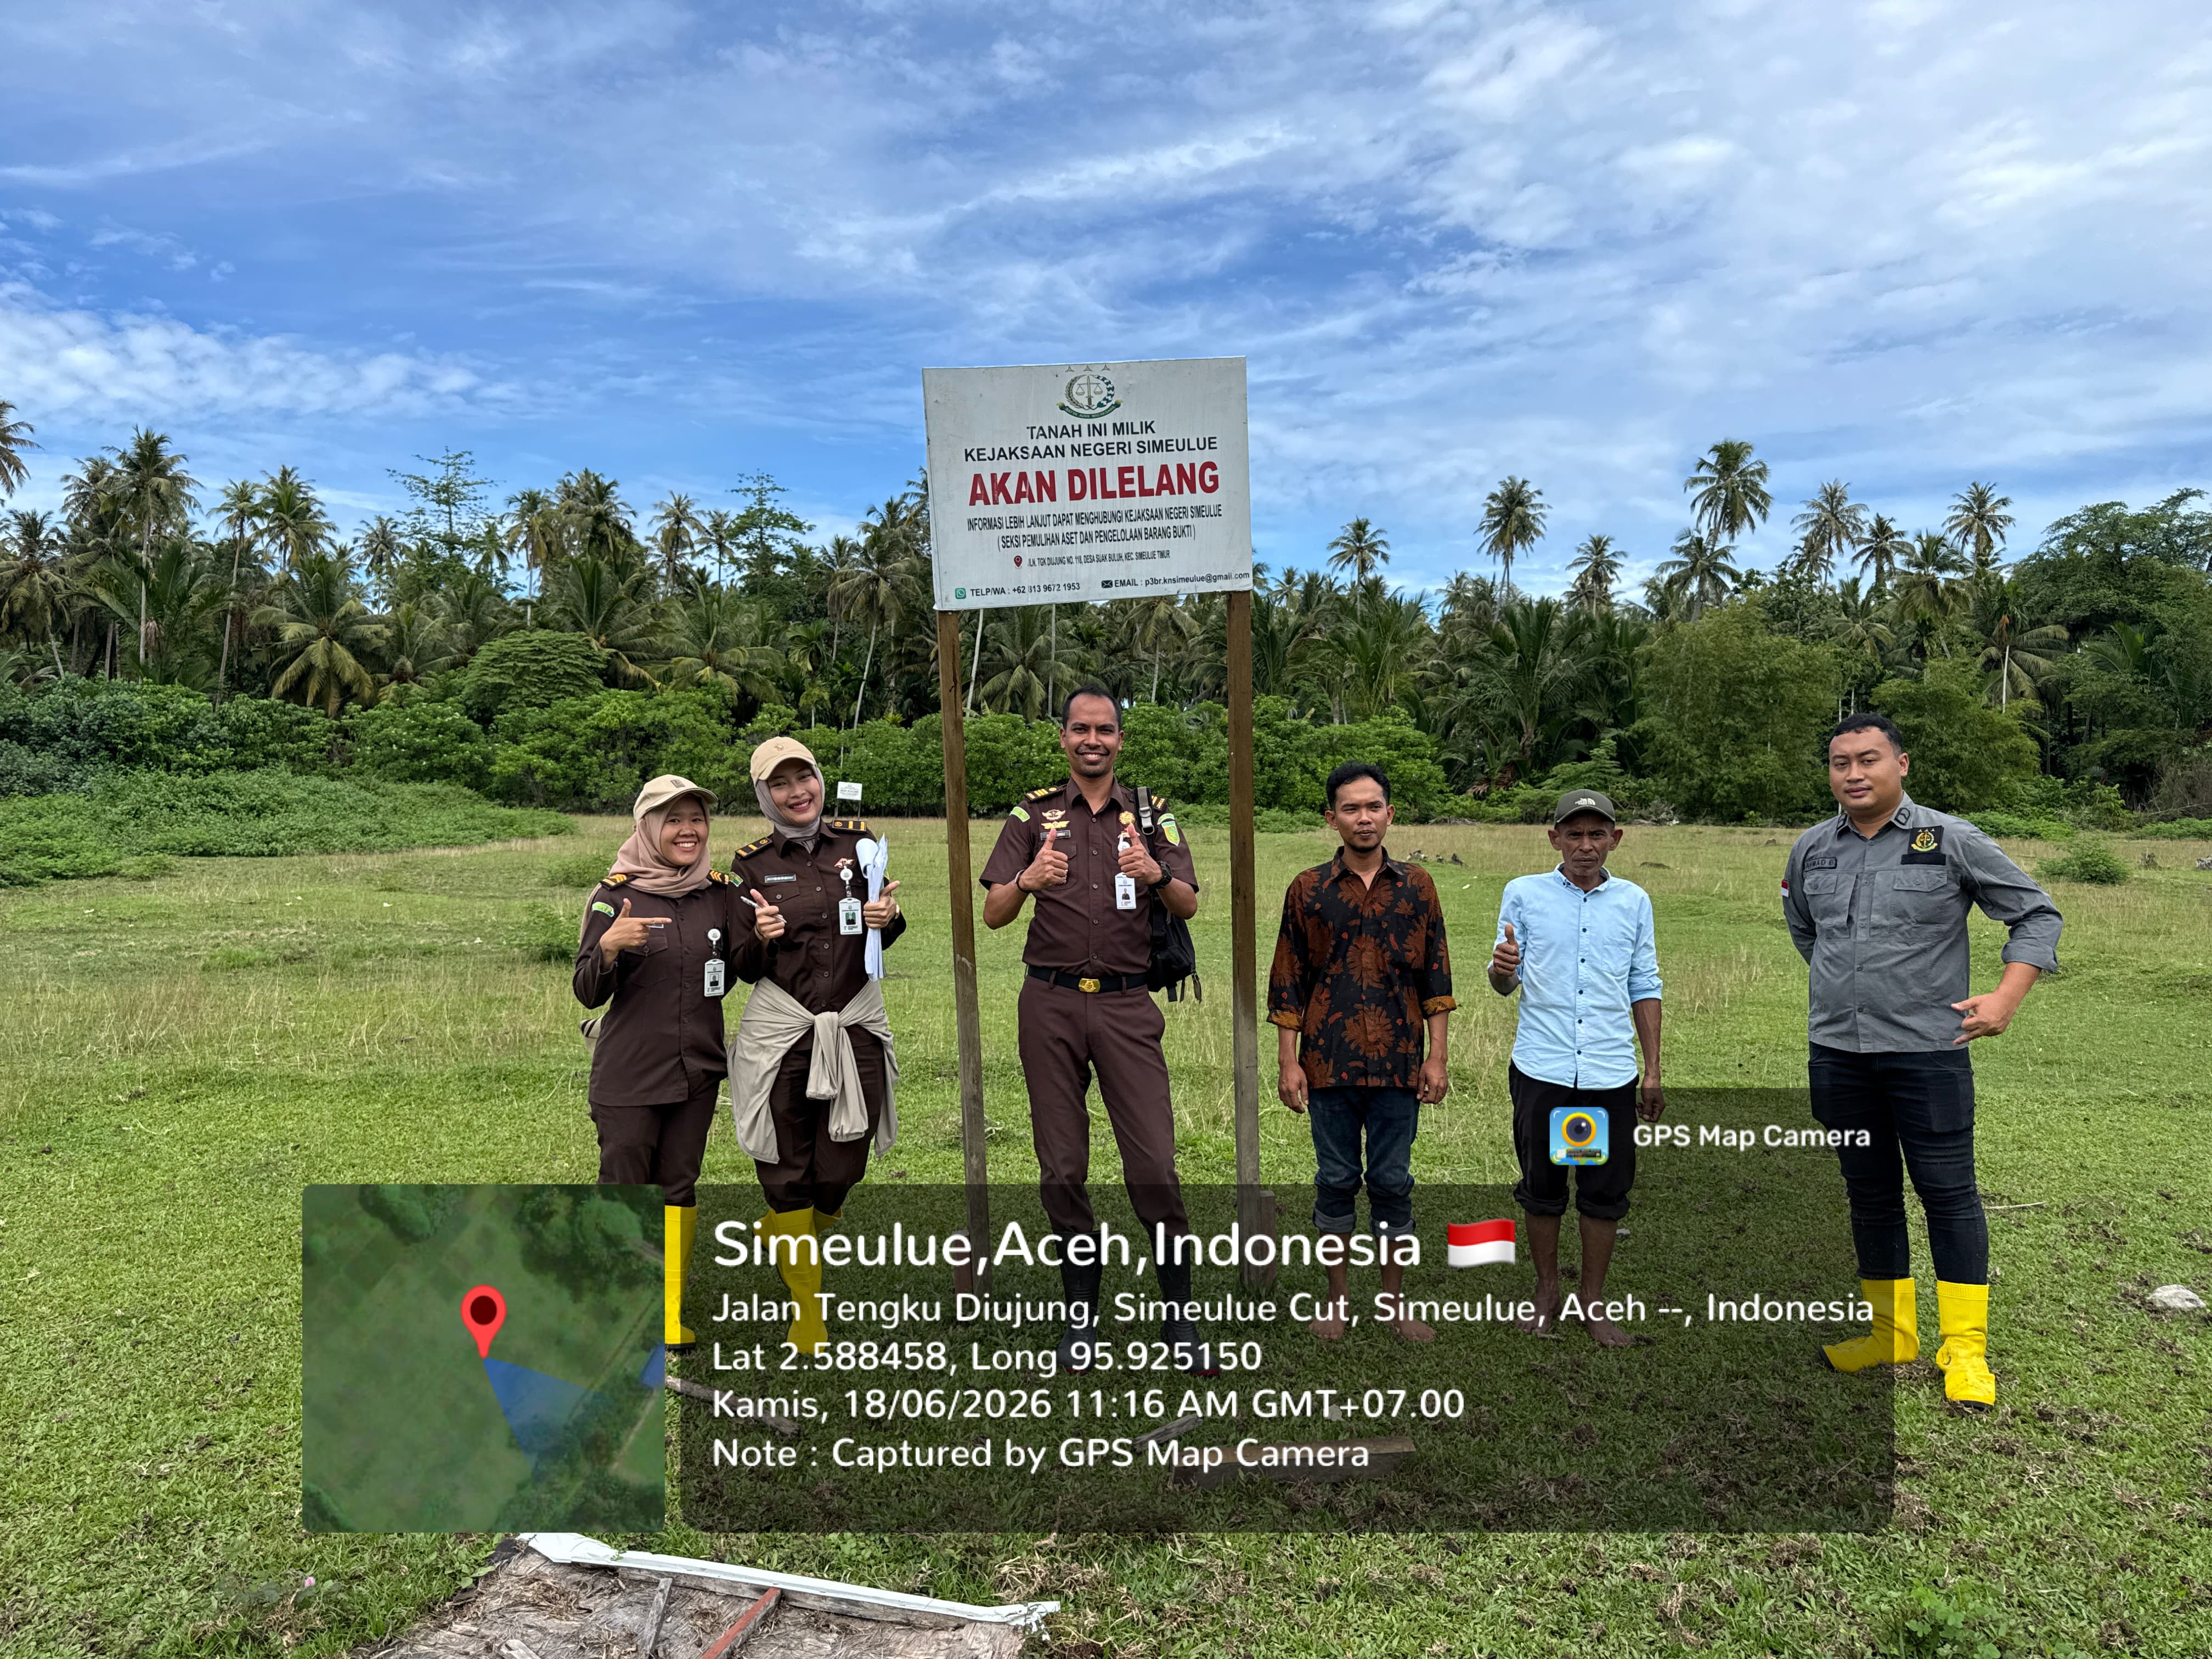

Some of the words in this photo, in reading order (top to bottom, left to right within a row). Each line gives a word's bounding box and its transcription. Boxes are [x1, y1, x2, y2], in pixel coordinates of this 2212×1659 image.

[1026, 424, 1082, 439] TANAH
[1087, 422, 1107, 437] INI
[1112, 420, 1156, 436] MILIK
[964, 444, 1065, 462] KEJAKSAAN
[1071, 441, 1132, 458] NEGERI
[1136, 437, 1217, 454] SIMEULUE
[969, 470, 1057, 506] AKAN
[1068, 461, 1219, 501] DILELANG
[967, 517, 1004, 532] INFORMASI
[1005, 515, 1024, 529] LEBIH
[1026, 514, 1051, 528] LANJUT
[1052, 512, 1074, 527] DAPAT
[1075, 509, 1123, 525] MENGHUBUNGI
[1125, 507, 1164, 522] KEJAKSAAN
[1165, 505, 1189, 520] NEGERI
[1190, 504, 1222, 518] SIMEULUE
[1001, 534, 1020, 549] SEKSI
[1023, 532, 1060, 548] PEMULIHAN
[1062, 531, 1078, 545] ASET
[1080, 530, 1093, 544] DAN
[1095, 527, 1143, 543] PENGELOLAAN
[1144, 526, 1171, 540] BARANG
[1173, 524, 1192, 539] BUKTI
[1037, 557, 1047, 566] TGK
[1047, 556, 1066, 566] DIUJUNG
[1084, 554, 1096, 564] DESA
[1096, 553, 1108, 563] SUAK
[1108, 552, 1124, 562] BULUH,
[1135, 550, 1156, 560] SIMEULUE
[1157, 550, 1170, 559] TIMUR
[970, 587, 1006, 597] TELP/WA
[1012, 585, 1026, 594] +62
[1043, 583, 1061, 592] 9672
[1063, 582, 1080, 591] 1953
[1114, 579, 1138, 588] EMAIL
[1145, 572, 1250, 588] p3br.knsimeulue@gmail.com
